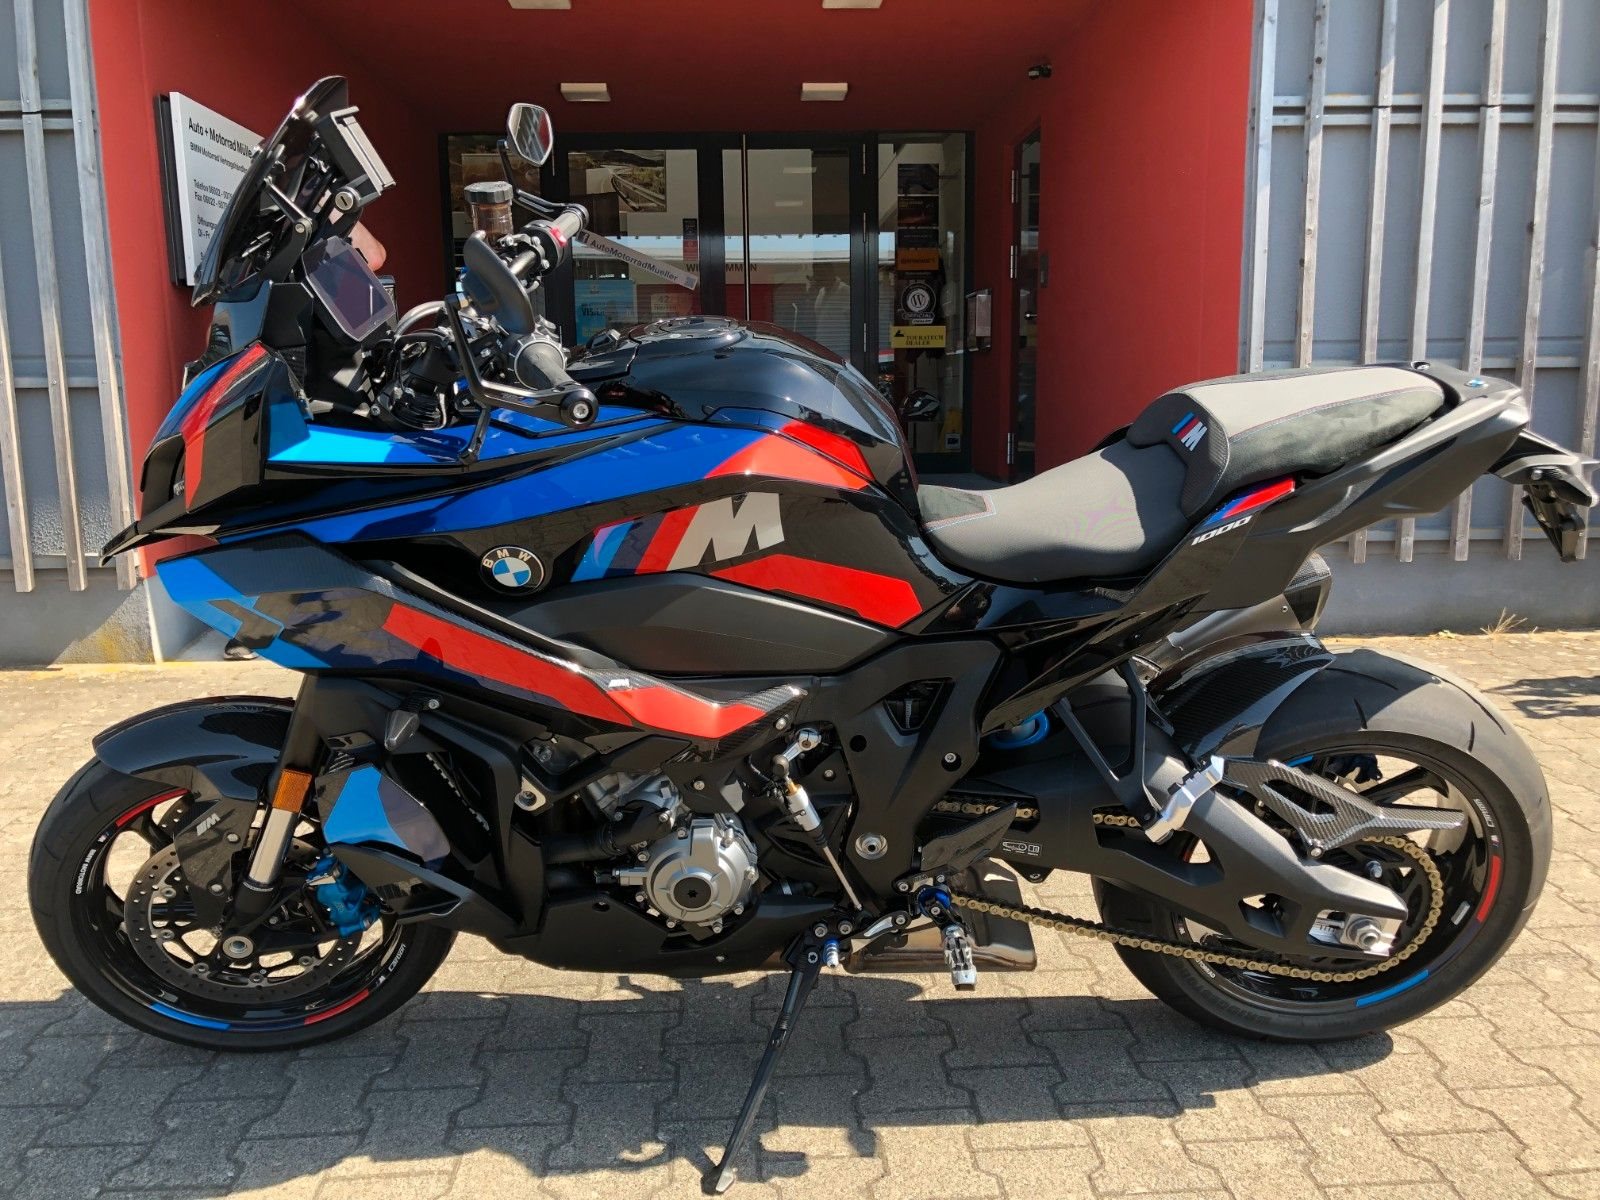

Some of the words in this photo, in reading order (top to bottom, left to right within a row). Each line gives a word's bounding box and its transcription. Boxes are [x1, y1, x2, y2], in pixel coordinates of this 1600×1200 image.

[188, 117, 204, 136] Auto
[209, 127, 237, 151] Motorrad
[590, 239, 679, 281] AutoMotorradMueller
[666, 491, 785, 572] M
[481, 548, 531, 569] BMW
